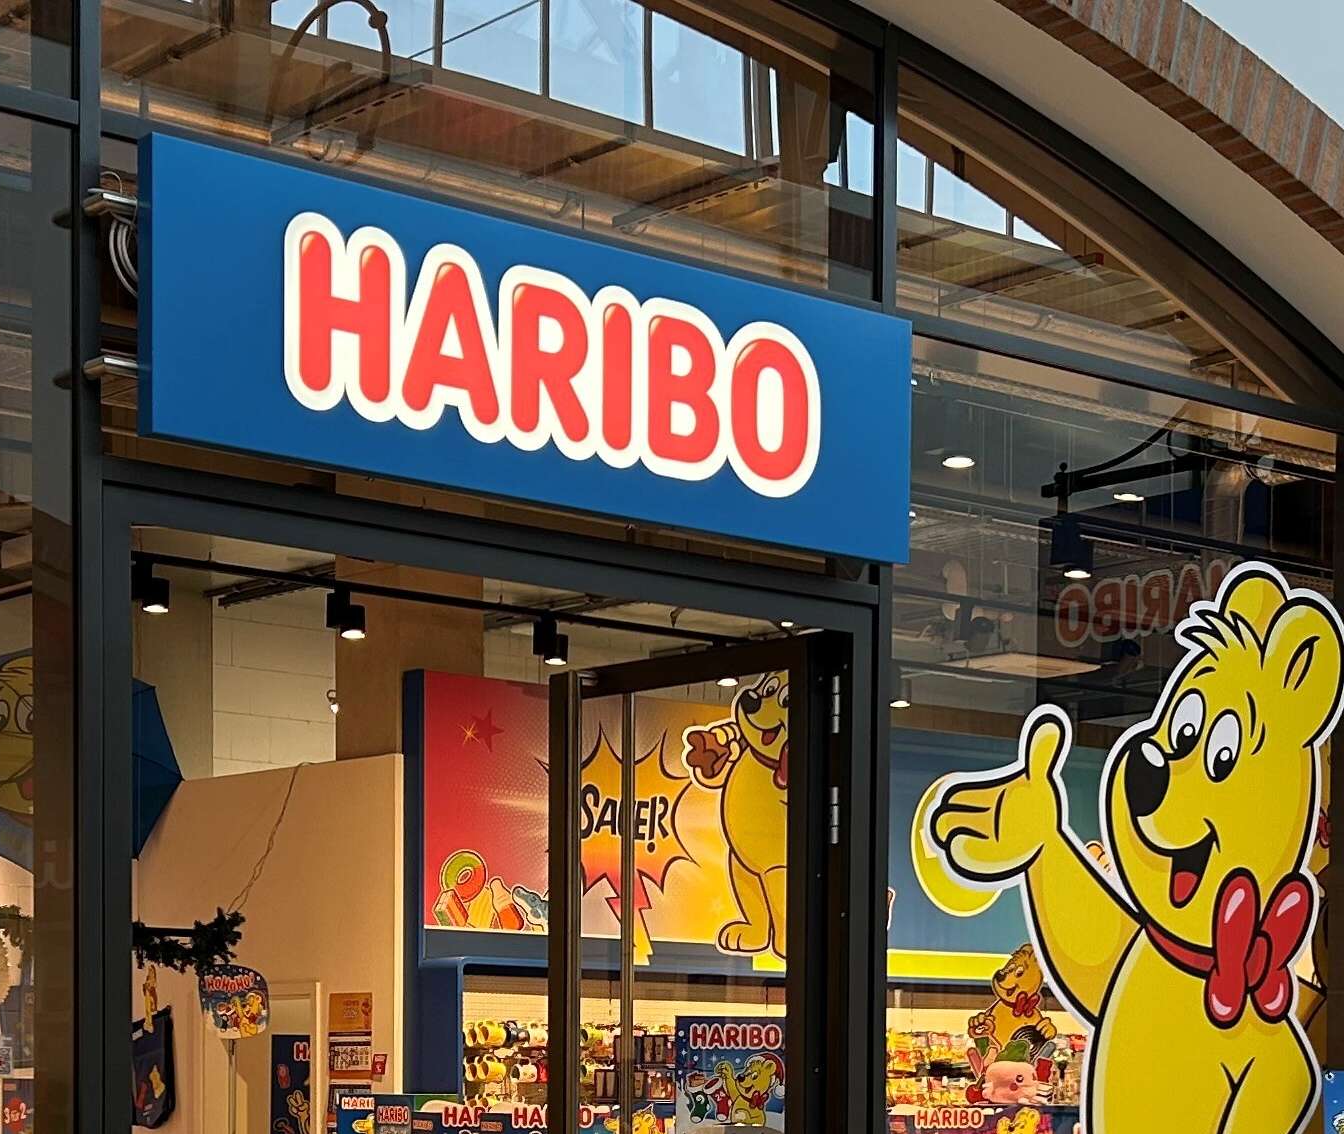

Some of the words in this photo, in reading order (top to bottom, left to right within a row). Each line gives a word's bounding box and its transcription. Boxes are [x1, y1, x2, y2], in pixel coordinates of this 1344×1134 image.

[294, 225, 812, 484] HARIBO
[691, 1024, 781, 1049] HARIBO
[378, 1107, 408, 1123] HARIBO
[916, 1109, 983, 1127] HARIBO
